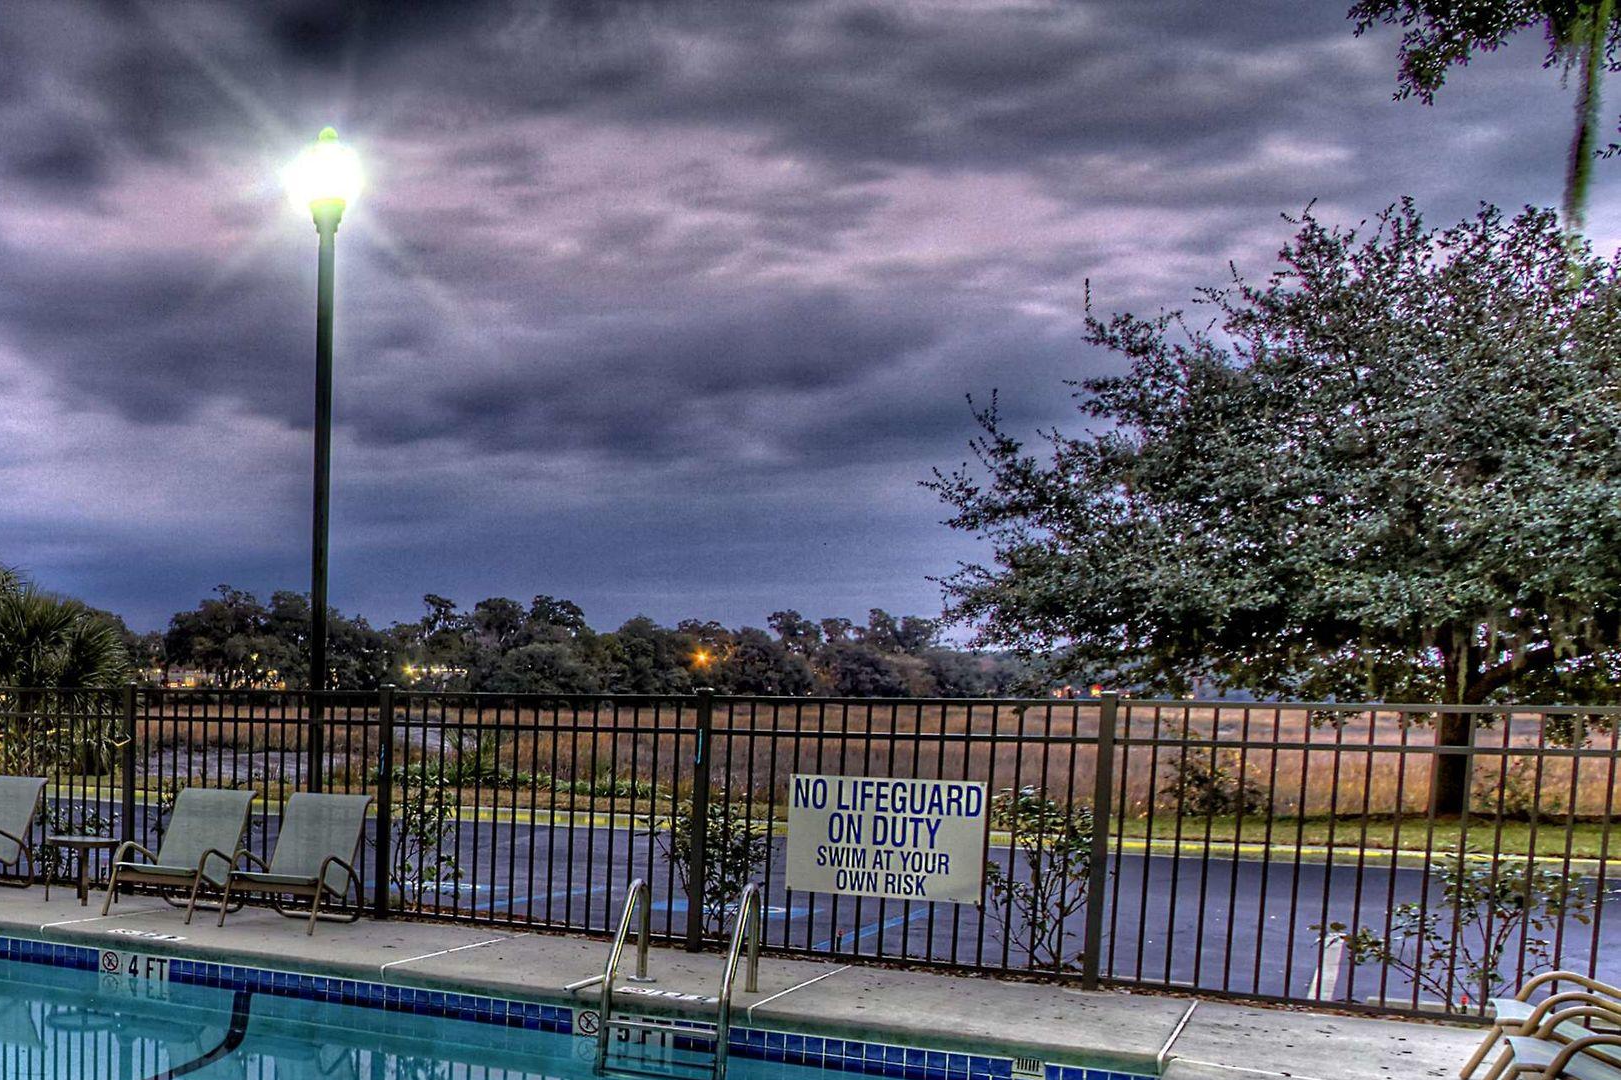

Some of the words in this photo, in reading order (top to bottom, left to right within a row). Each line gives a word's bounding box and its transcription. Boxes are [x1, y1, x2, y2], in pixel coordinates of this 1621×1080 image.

[794, 778, 827, 810] NO
[837, 779, 983, 817] LIFEGUARD
[828, 812, 862, 844] ON
[872, 815, 942, 849] DUTY
[816, 845, 866, 870] SWIM
[872, 849, 894, 871] AT
[901, 851, 950, 875] YOUR
[836, 869, 878, 892] OWN
[884, 873, 926, 896] RISK
[129, 955, 139, 978] 4
[146, 957, 168, 981] FT
[641, 1017, 671, 1048] FT
